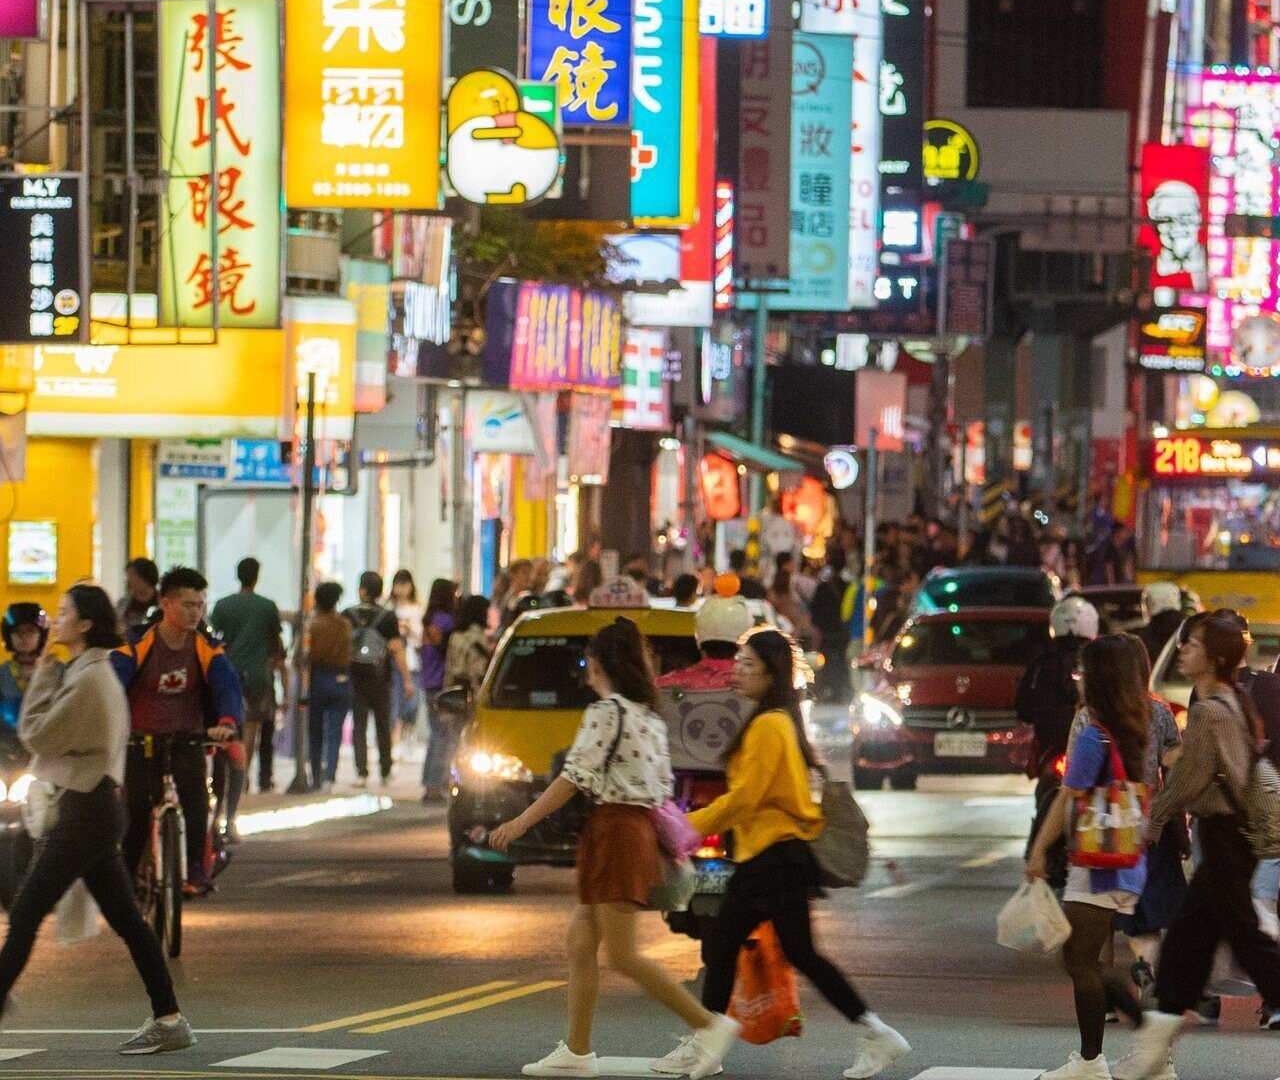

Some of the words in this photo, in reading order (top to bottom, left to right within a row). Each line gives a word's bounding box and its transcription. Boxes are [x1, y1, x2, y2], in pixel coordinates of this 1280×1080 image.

[185, 7, 258, 318] 張氏眼鏡
[1155, 437, 1201, 473] 218
